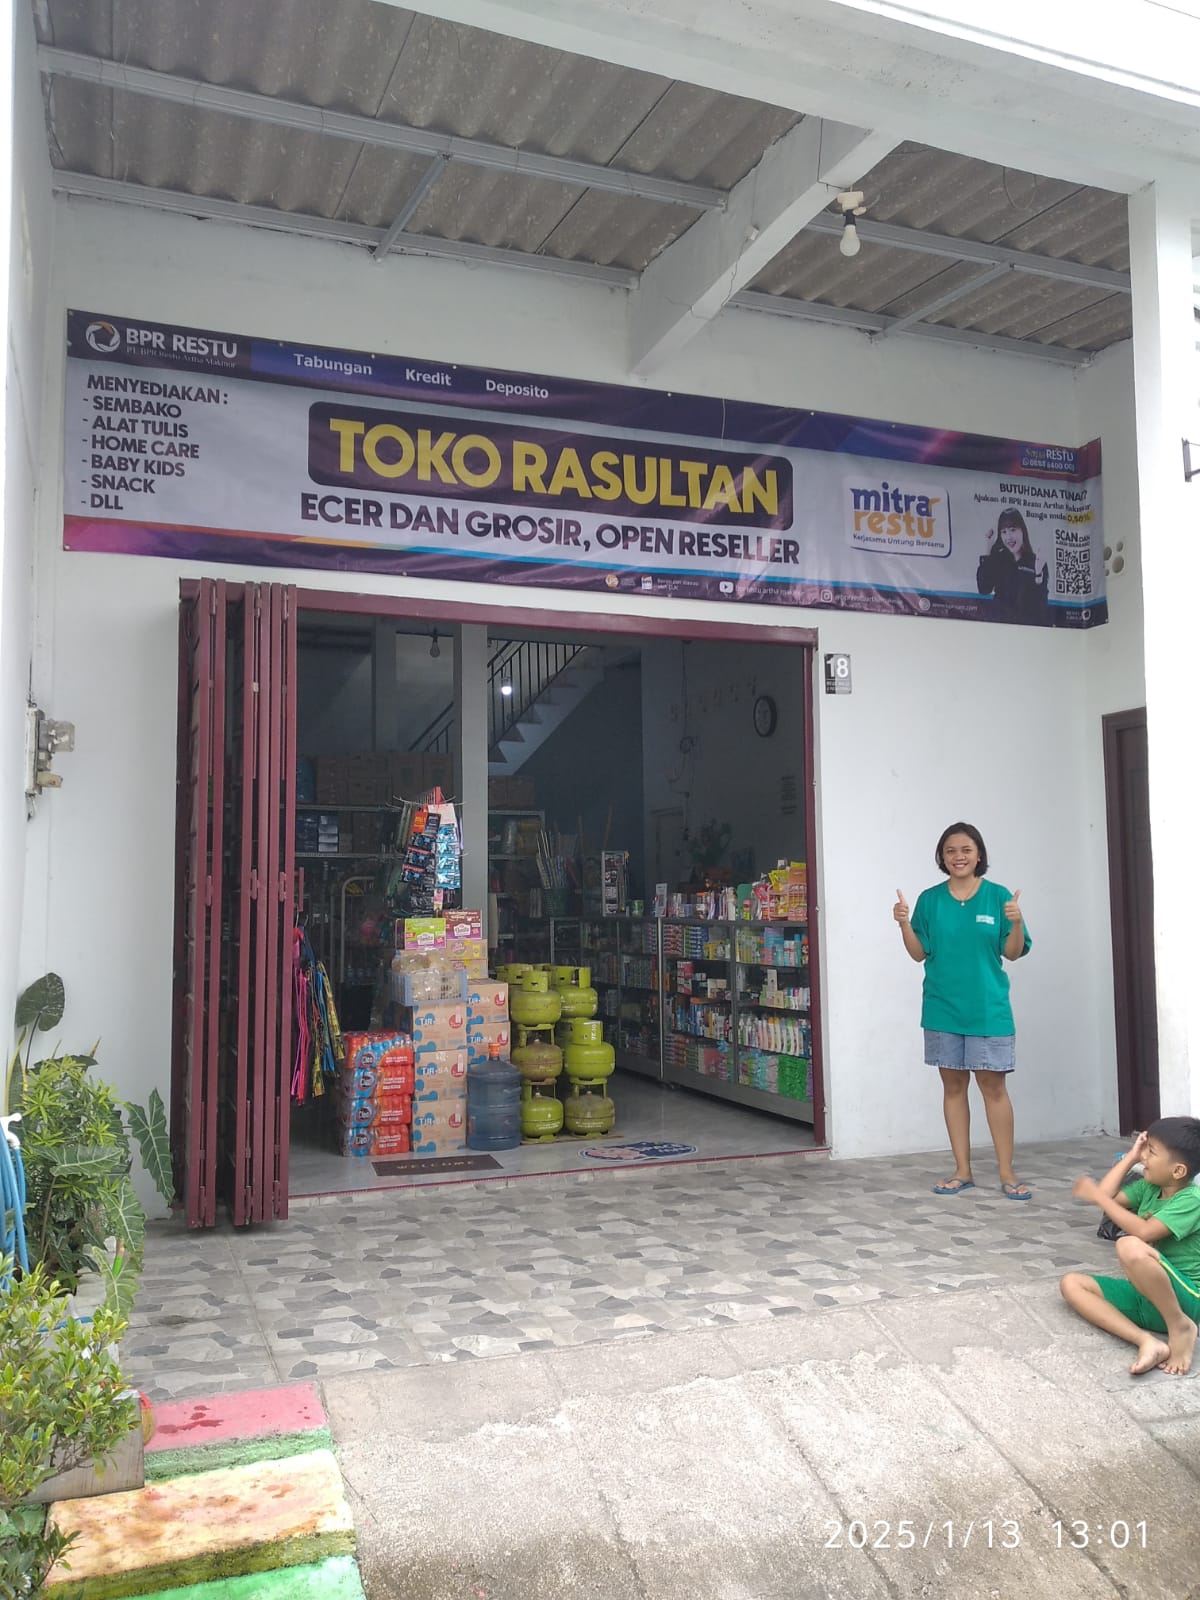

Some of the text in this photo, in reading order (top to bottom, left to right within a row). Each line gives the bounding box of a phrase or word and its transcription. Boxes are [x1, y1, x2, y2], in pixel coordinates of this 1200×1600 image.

[126, 327, 238, 359] BPR RESTU
[294, 353, 373, 377] Tabungan
[405, 368, 452, 387] Kredit
[485, 379, 549, 399] Deposito
[92, 395, 182, 418] SEMBAKO
[92, 416, 139, 434] ALAT
[141, 420, 189, 438] TULIS
[91, 435, 147, 455] HOME
[151, 441, 200, 459] CARE
[91, 455, 140, 473] BABY
[144, 459, 186, 477] KIDS
[329, 418, 779, 516] TOKO RASULTAN
[91, 475, 155, 494] SNACK
[1000, 483, 1030, 496] BUTUH
[1030, 487, 1058, 500] DANA
[90, 494, 124, 510] DLL
[849, 481, 934, 518] mitra
[853, 511, 937, 539] restu
[1025, 510, 1048, 523] Bunga
[301, 492, 800, 565] ECER DAN GROSIR, OPEN RESELLER
[1055, 529, 1079, 543] SCAN
[853, 533, 945, 549] Kerjasama Untung Bersama
[826, 657, 849, 678] 18
